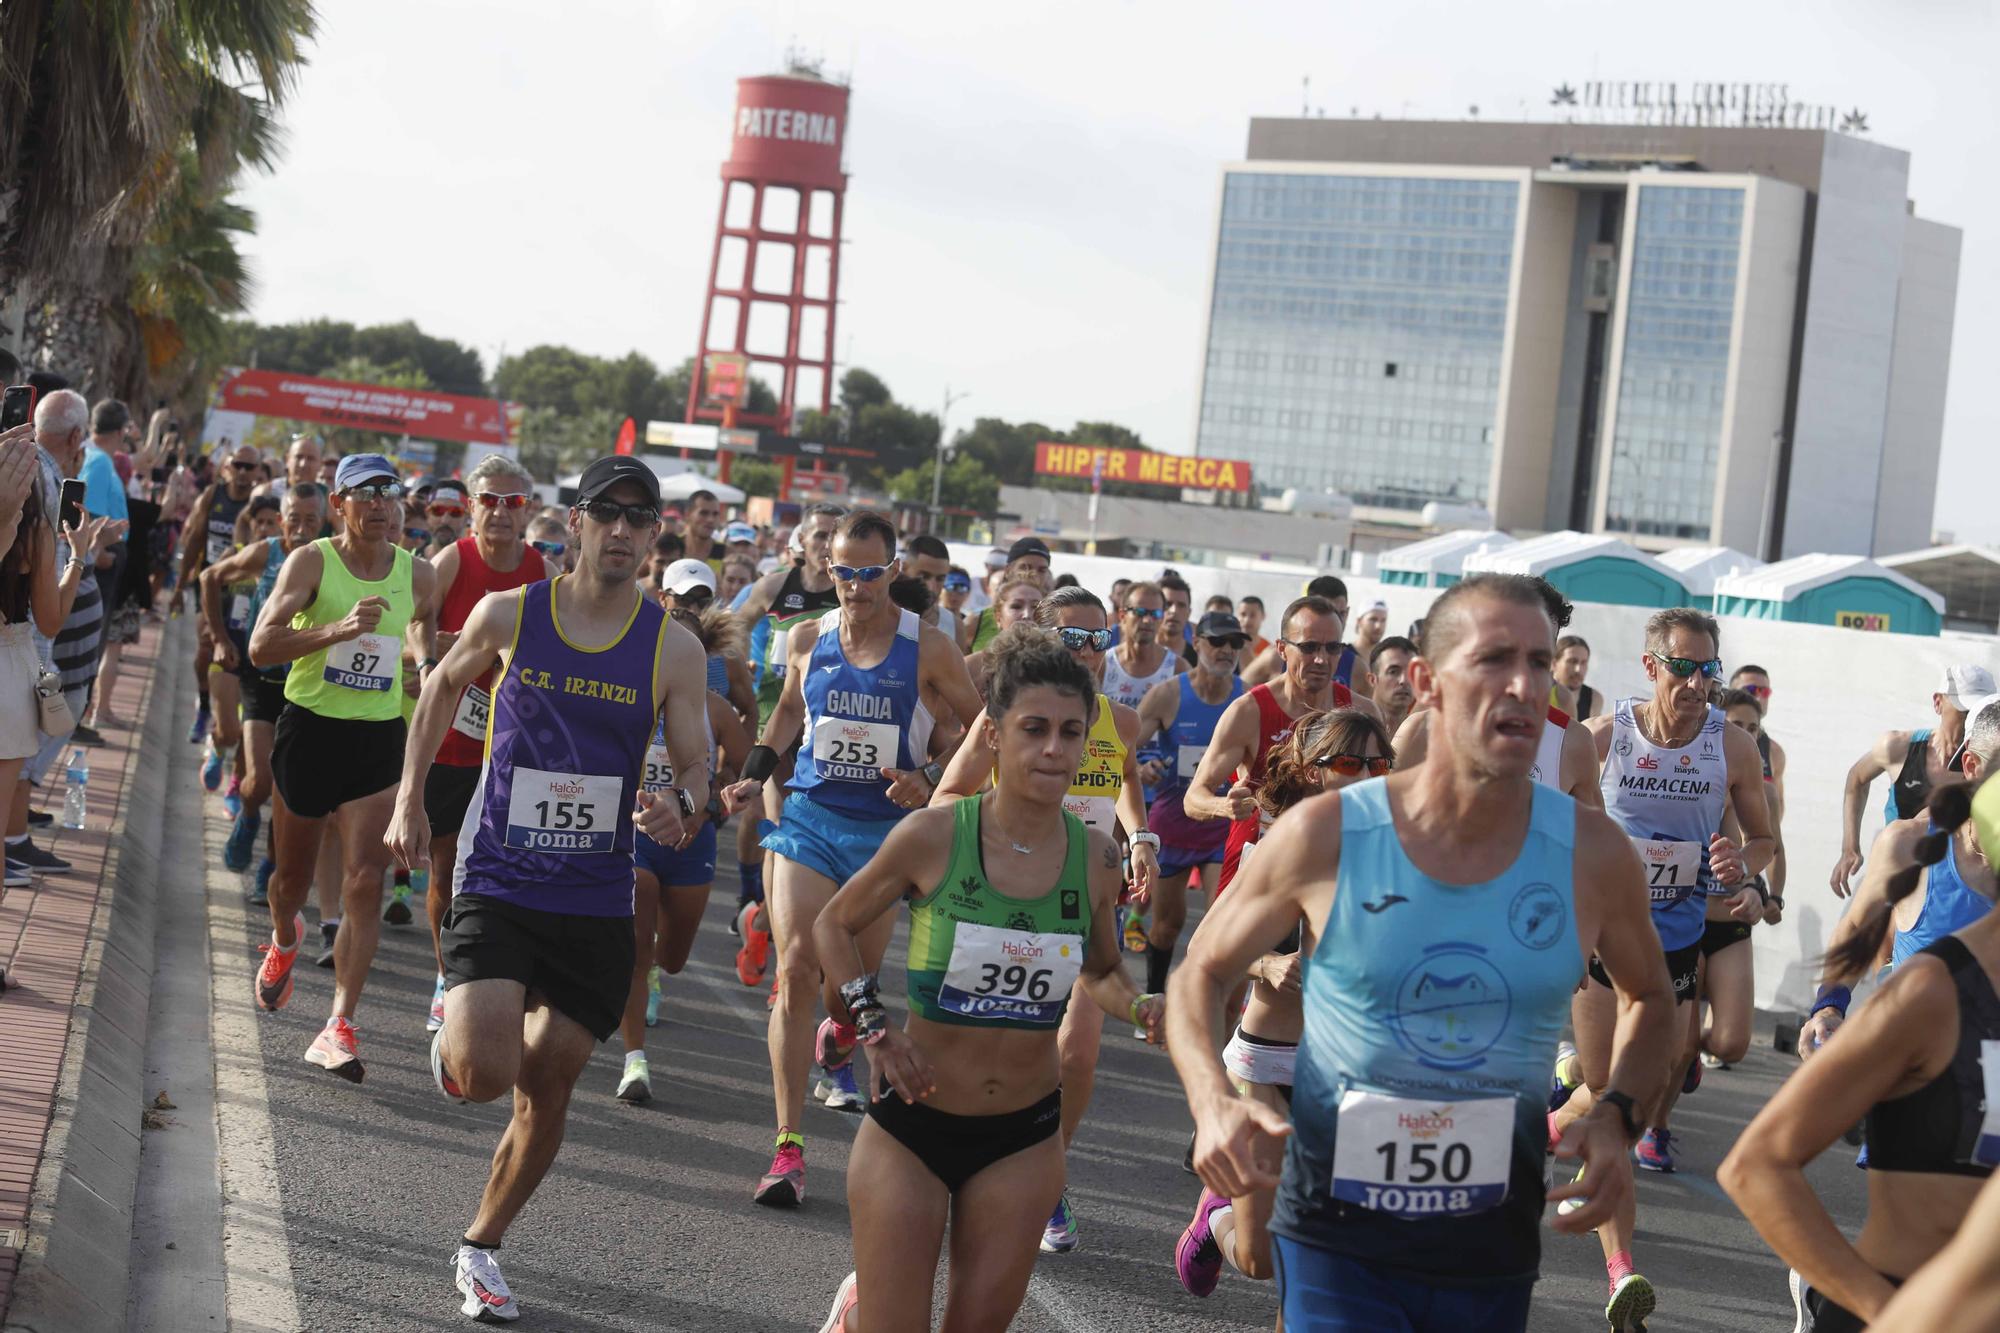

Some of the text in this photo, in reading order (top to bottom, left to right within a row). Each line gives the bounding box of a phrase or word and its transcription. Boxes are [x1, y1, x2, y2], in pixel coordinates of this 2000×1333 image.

[738, 106, 836, 145] PATERNA
[1046, 446, 1237, 489] HIPER MERCA
[1843, 615, 1883, 631] BOXI
[351, 652, 380, 674] 87
[520, 668, 556, 690] C.A.
[827, 689, 892, 720] GANDIA
[829, 740, 878, 766] 253
[1619, 775, 1711, 795] MARACENA
[535, 800, 595, 830] 155
[524, 831, 593, 848] Joma
[1645, 864, 1679, 885] 71
[974, 963, 1053, 1001] 396
[1375, 1141, 1473, 1184] 150
[1360, 1185, 1472, 1213] Joma
